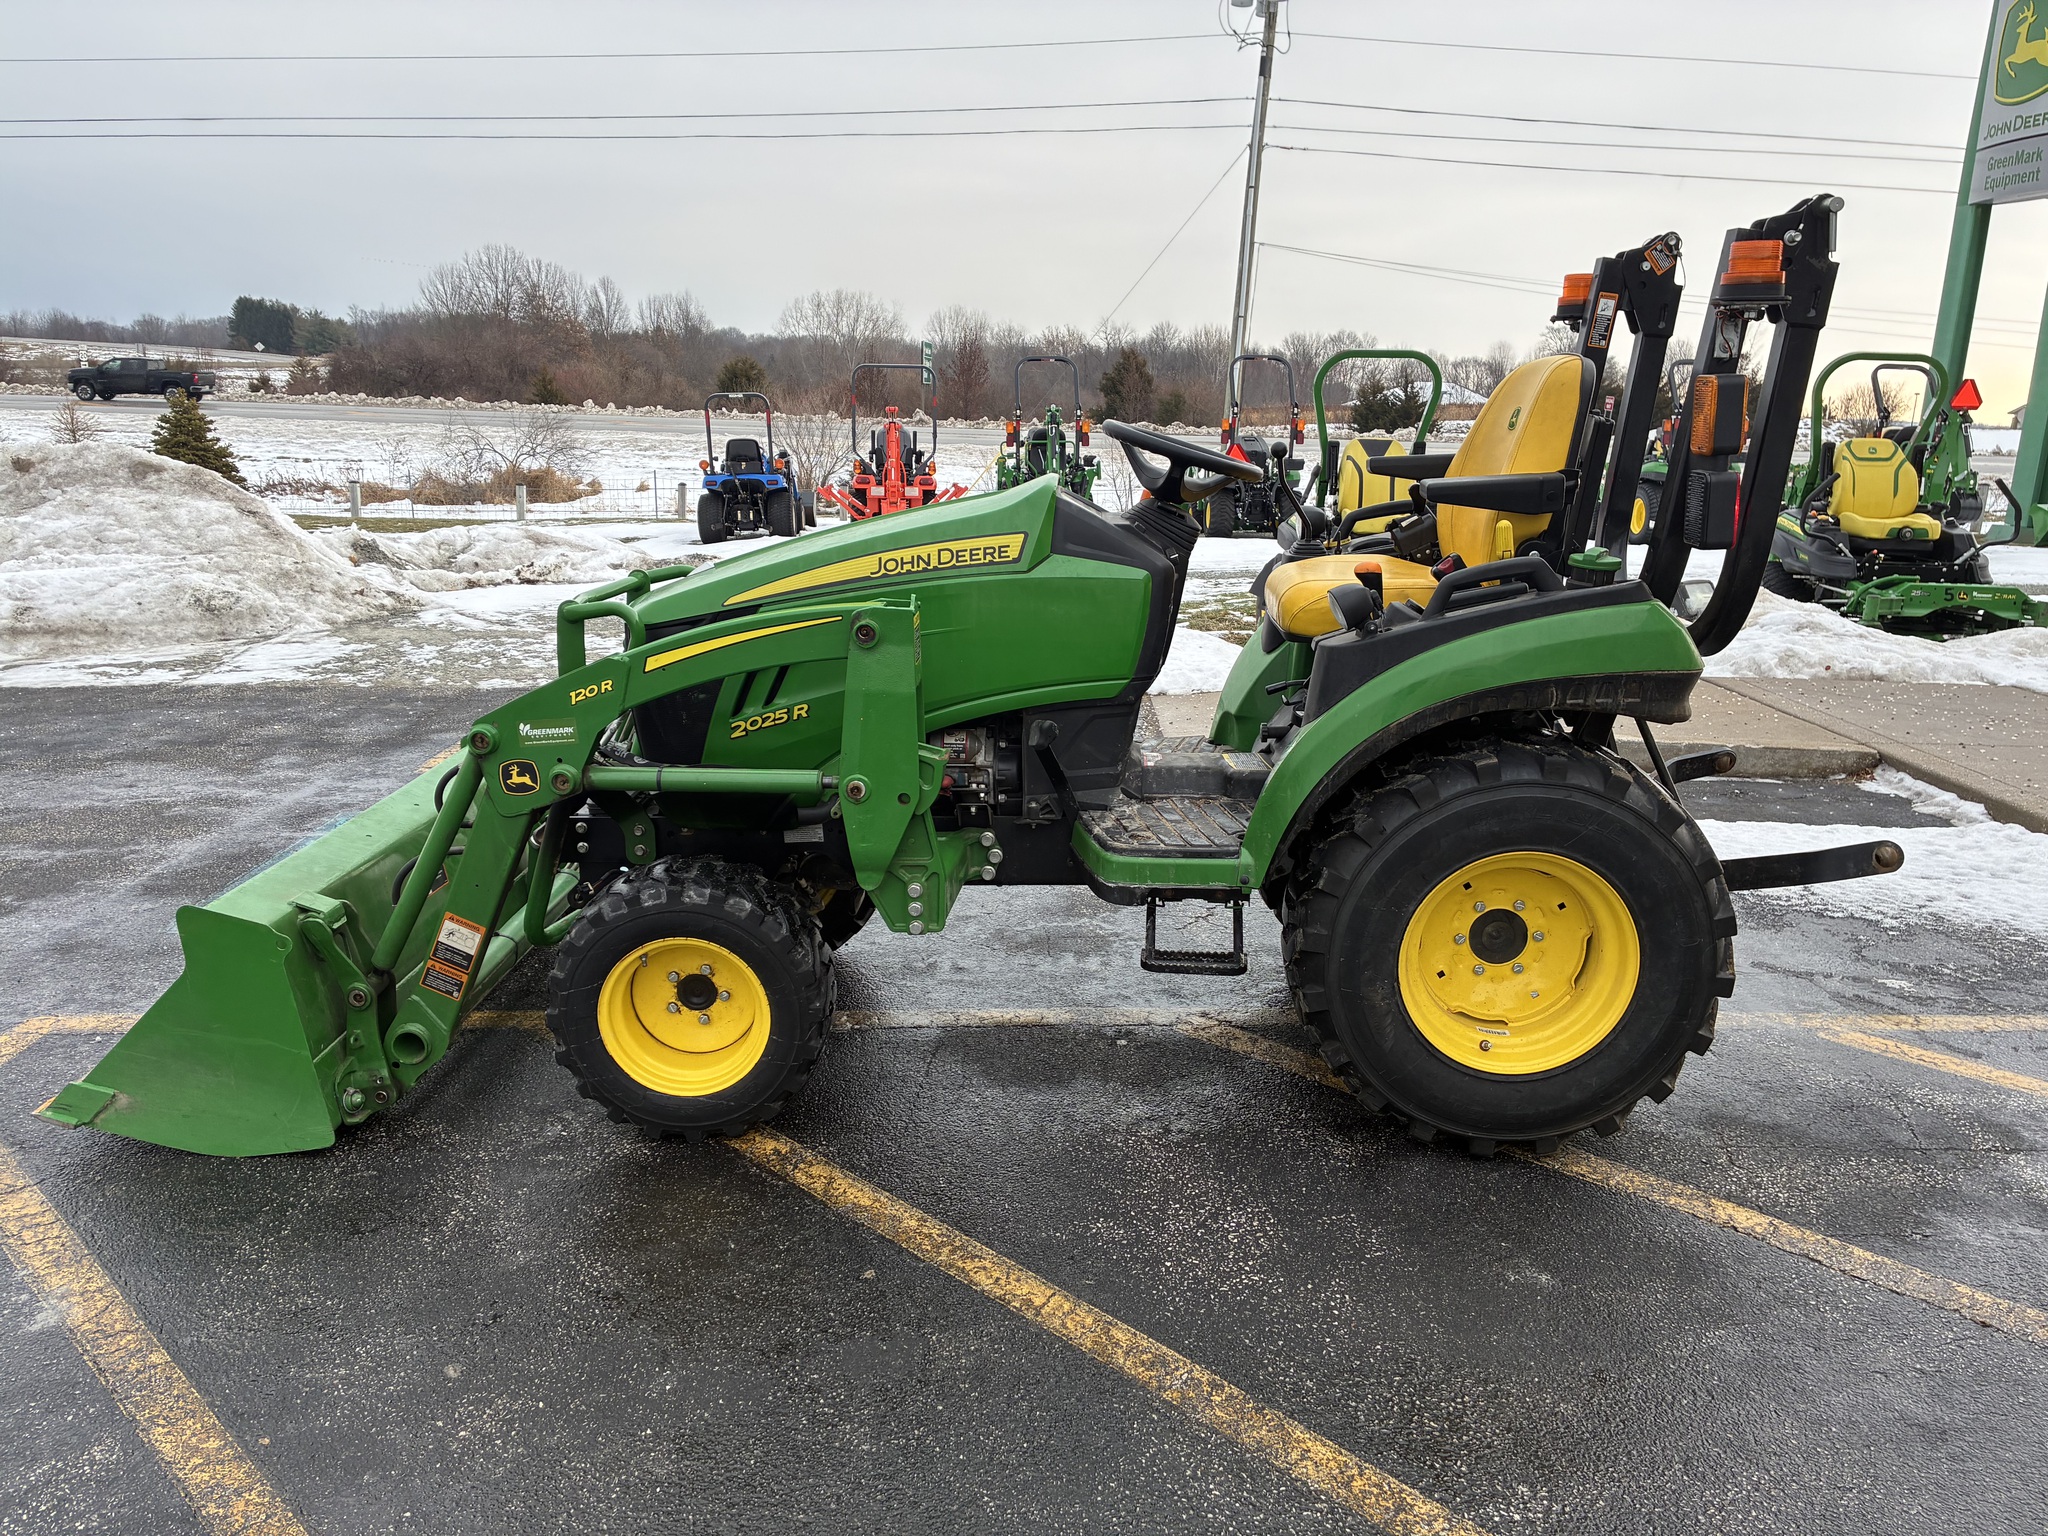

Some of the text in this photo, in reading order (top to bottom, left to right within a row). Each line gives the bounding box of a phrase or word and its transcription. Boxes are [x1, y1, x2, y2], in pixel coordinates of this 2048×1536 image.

[1984, 120, 2012, 140] JOHN
[1987, 147, 2044, 171] GreenMark
[1984, 167, 2041, 192] Equipment
[870, 545, 1011, 576] JOHN DEERE
[1944, 588, 1955, 602] 5
[569, 680, 613, 705] 120 R
[527, 727, 574, 736] GREENMARK
[730, 703, 809, 739] 2025 R
[455, 916, 480, 932] WARNING
[438, 966, 463, 979] WARNING
